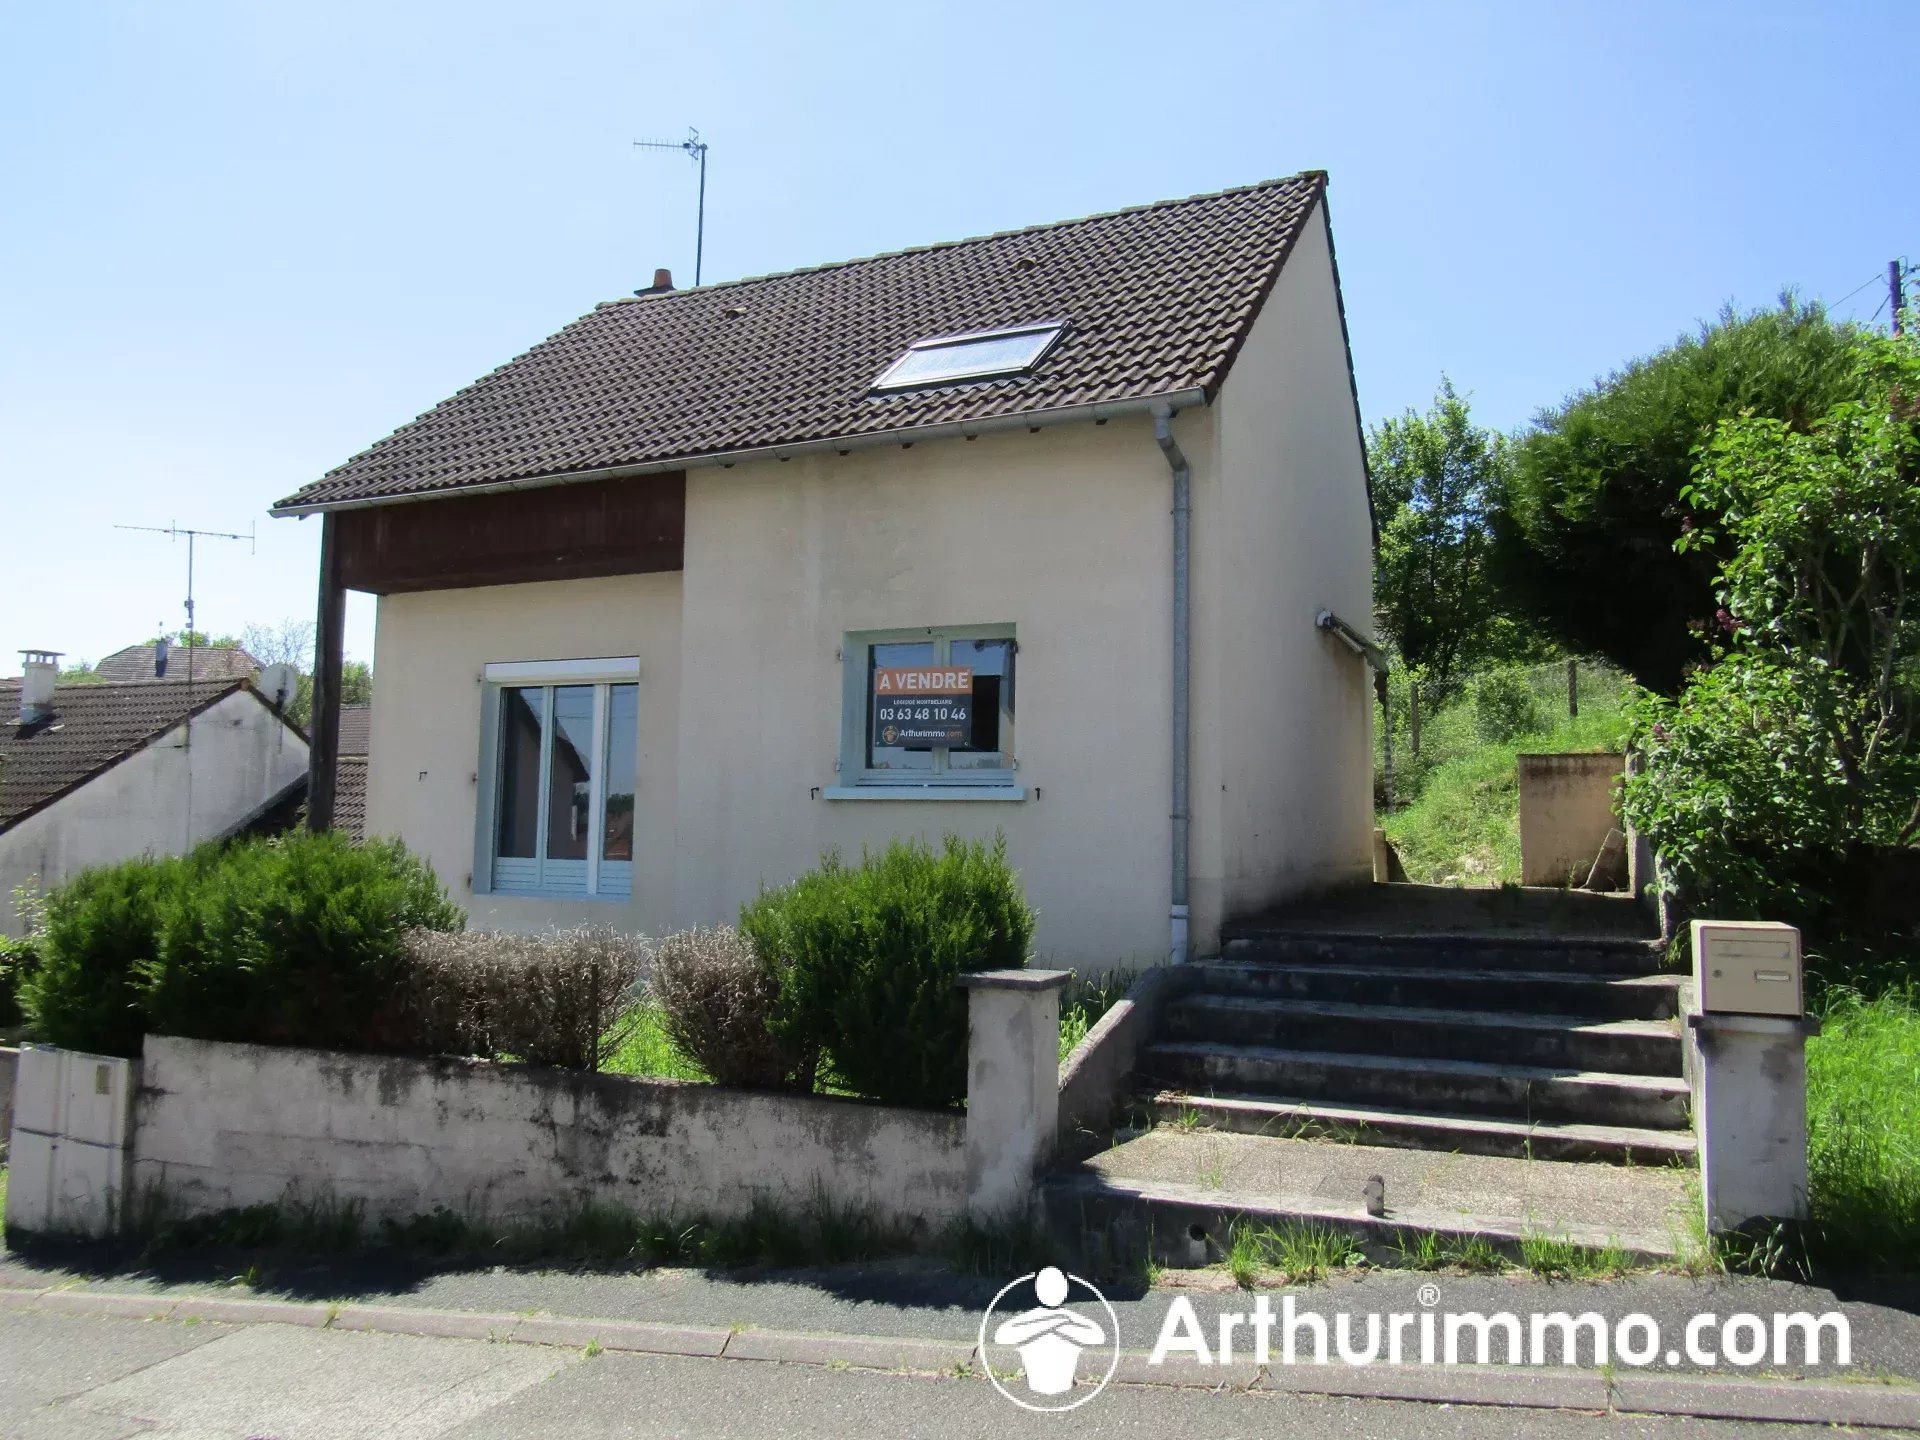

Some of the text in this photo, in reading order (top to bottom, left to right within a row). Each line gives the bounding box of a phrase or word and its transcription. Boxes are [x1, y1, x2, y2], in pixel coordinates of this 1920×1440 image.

[880, 672, 969, 690] A VENDRE
[880, 708, 966, 720] 03 63 48 10 46
